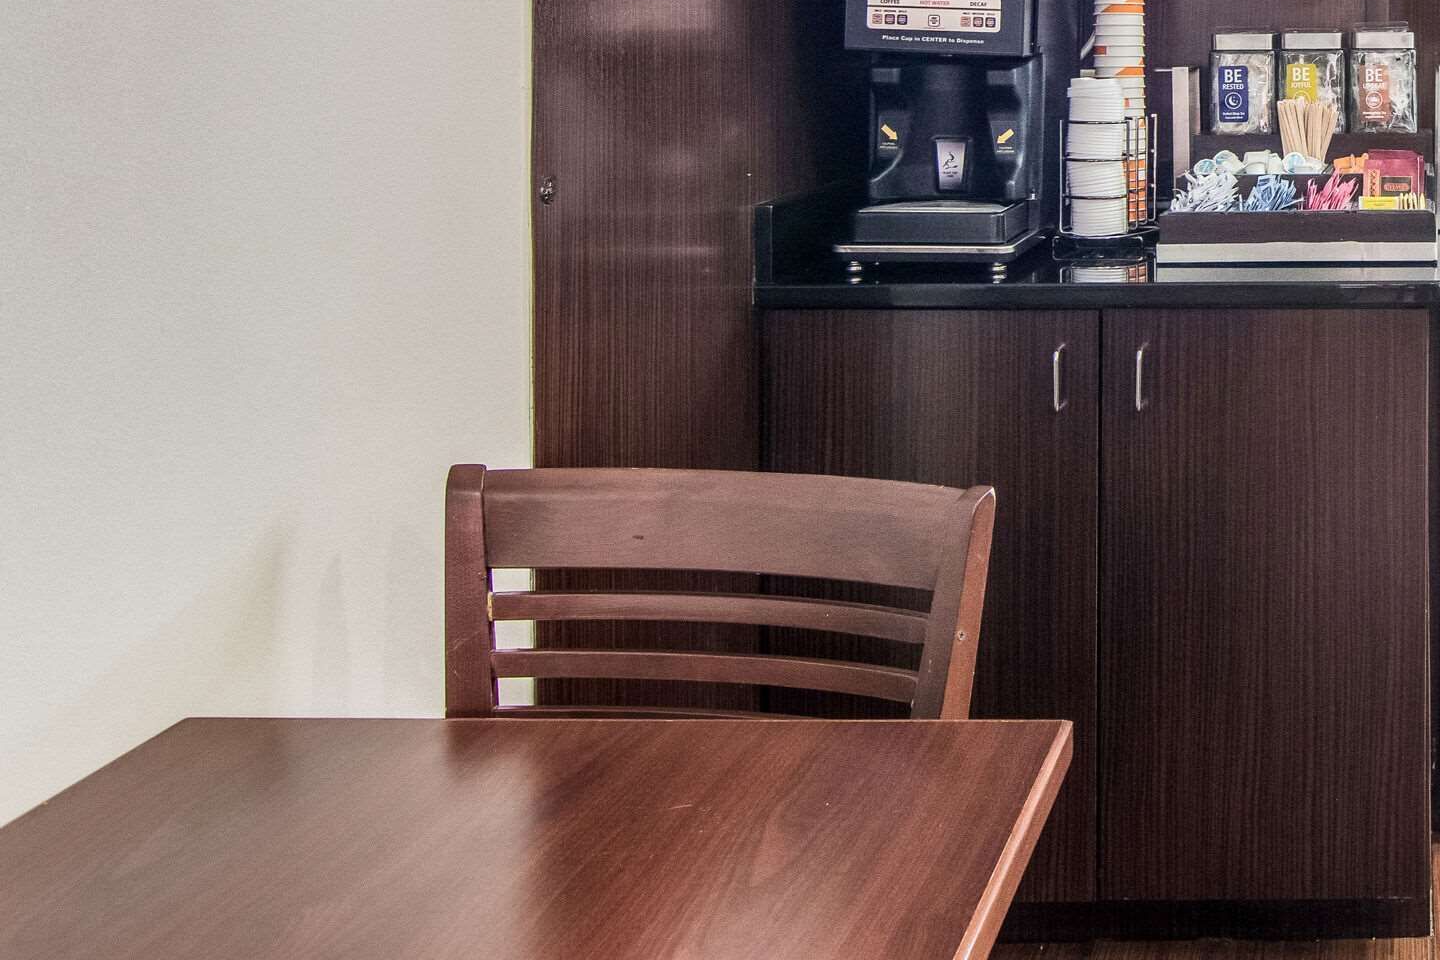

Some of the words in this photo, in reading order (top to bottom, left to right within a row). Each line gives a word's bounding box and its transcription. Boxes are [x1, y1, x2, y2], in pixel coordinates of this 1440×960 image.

[1224, 69, 1243, 83] BE
[1292, 67, 1310, 81] BE
[1365, 68, 1383, 82] BE
